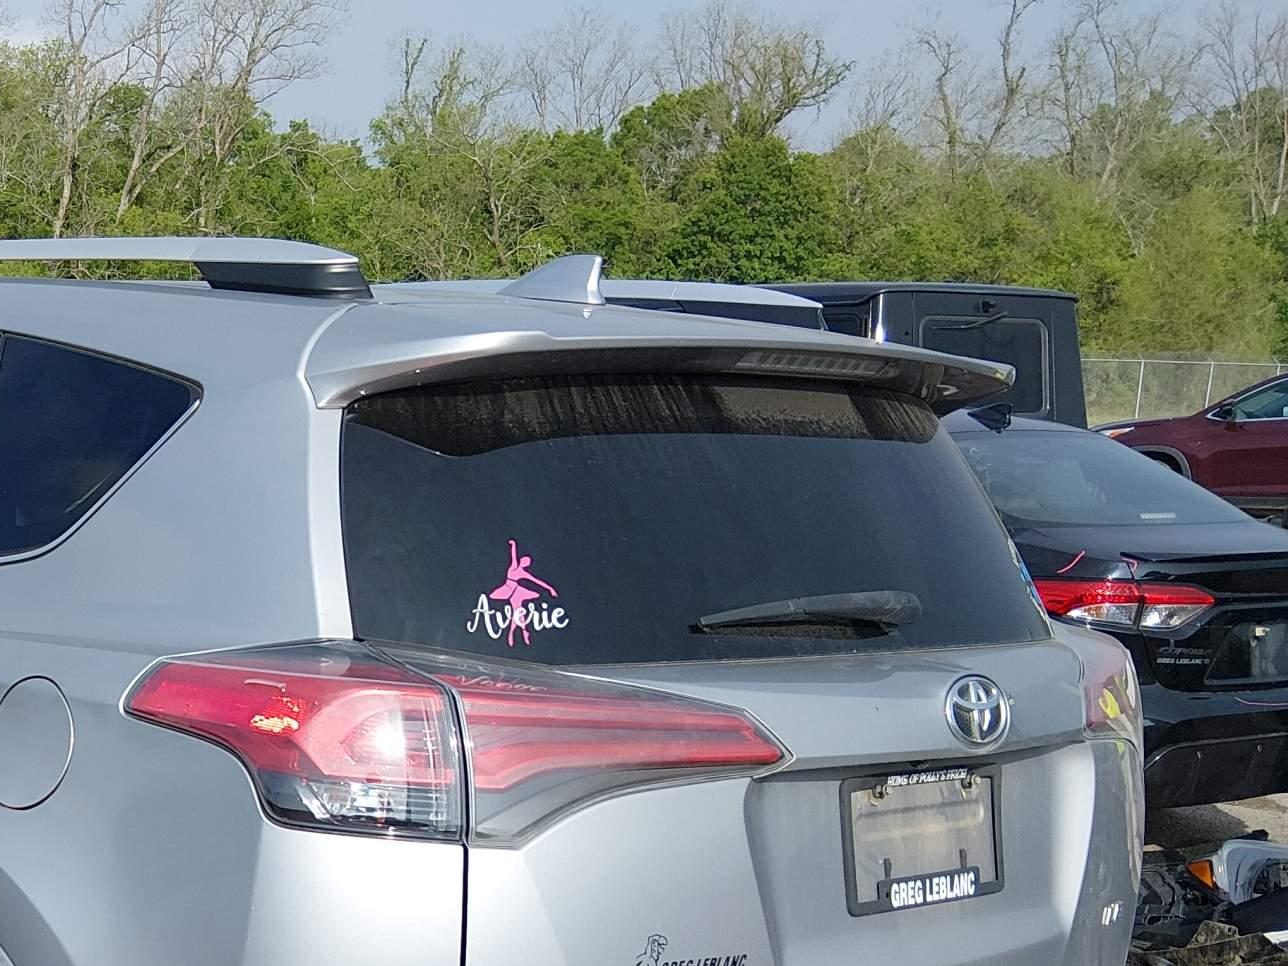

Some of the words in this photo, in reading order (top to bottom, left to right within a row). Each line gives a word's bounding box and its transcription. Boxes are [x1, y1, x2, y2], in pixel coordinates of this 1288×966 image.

[466, 593, 569, 639] Averie
[909, 773, 919, 784] OF
[891, 880, 924, 908] GREG
[925, 871, 975, 902] LEBLANC
